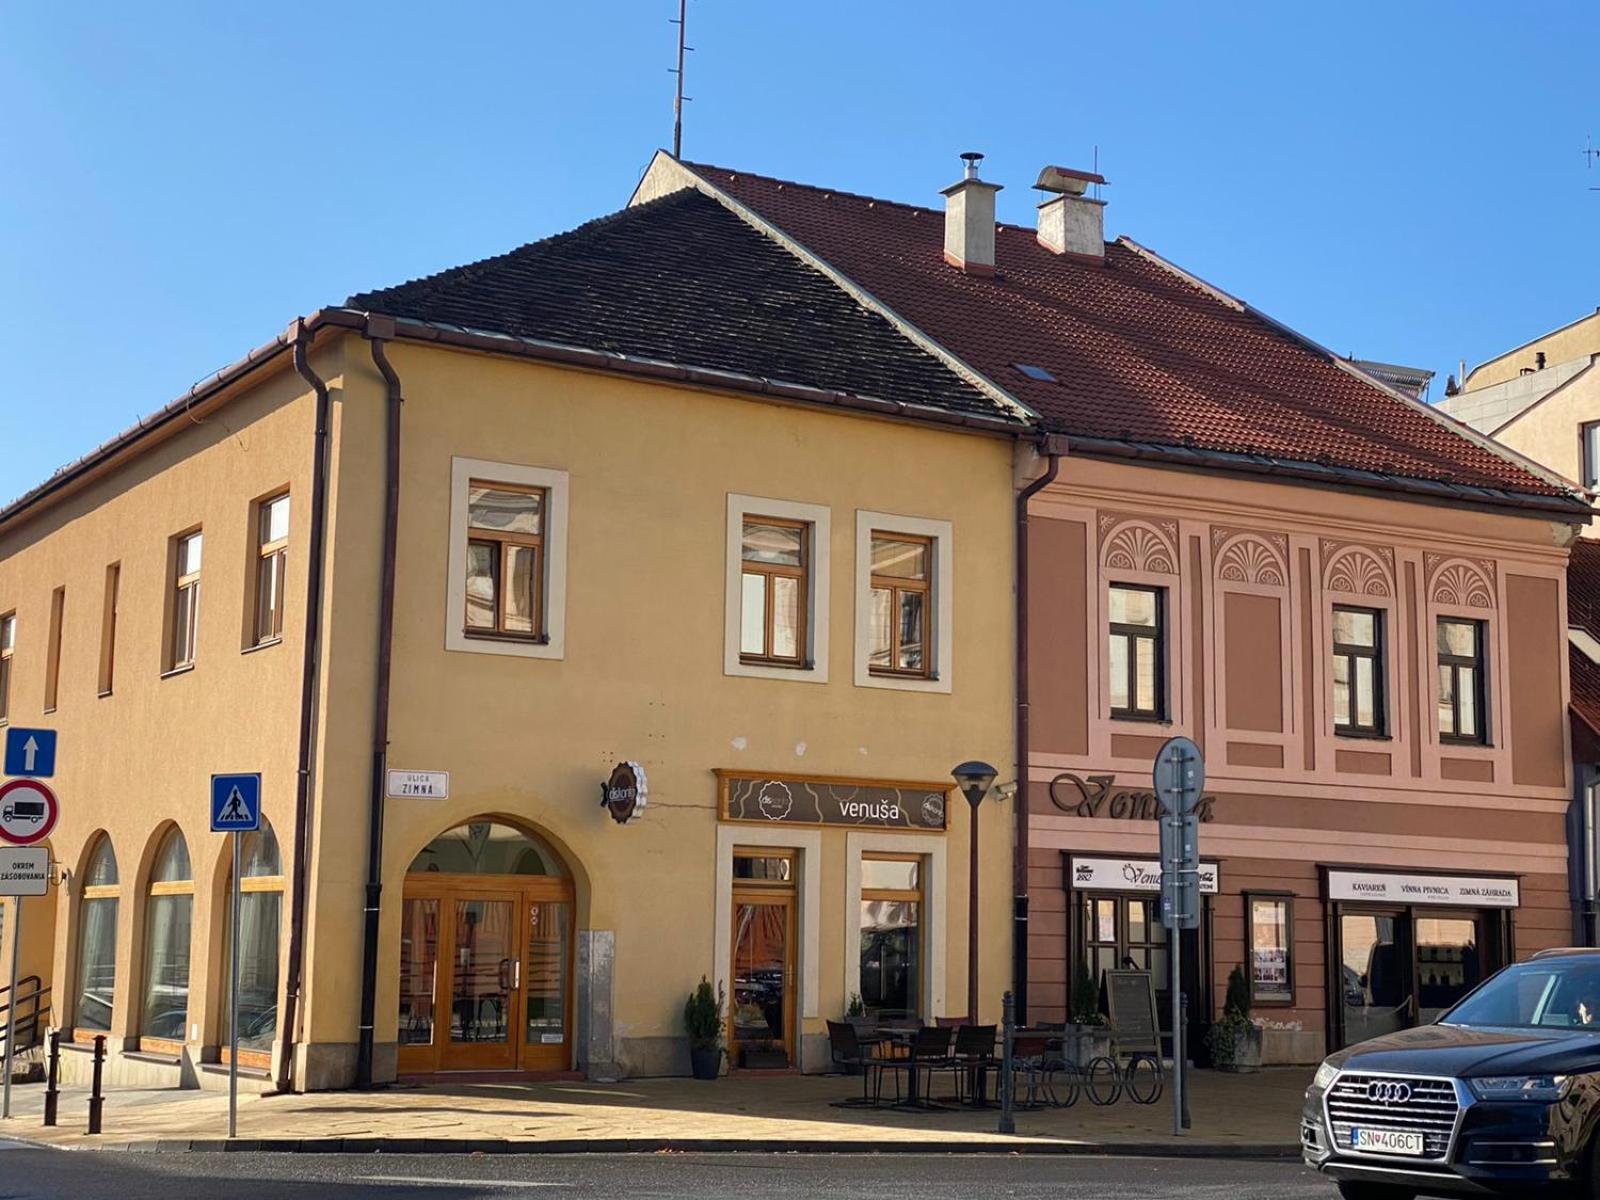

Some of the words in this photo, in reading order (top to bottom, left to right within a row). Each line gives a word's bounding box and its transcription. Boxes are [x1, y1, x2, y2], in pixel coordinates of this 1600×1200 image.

[840, 799, 899, 819] venuša
[12, 862, 34, 870] OKREM
[1423, 886, 1449, 895] PIVNICA
